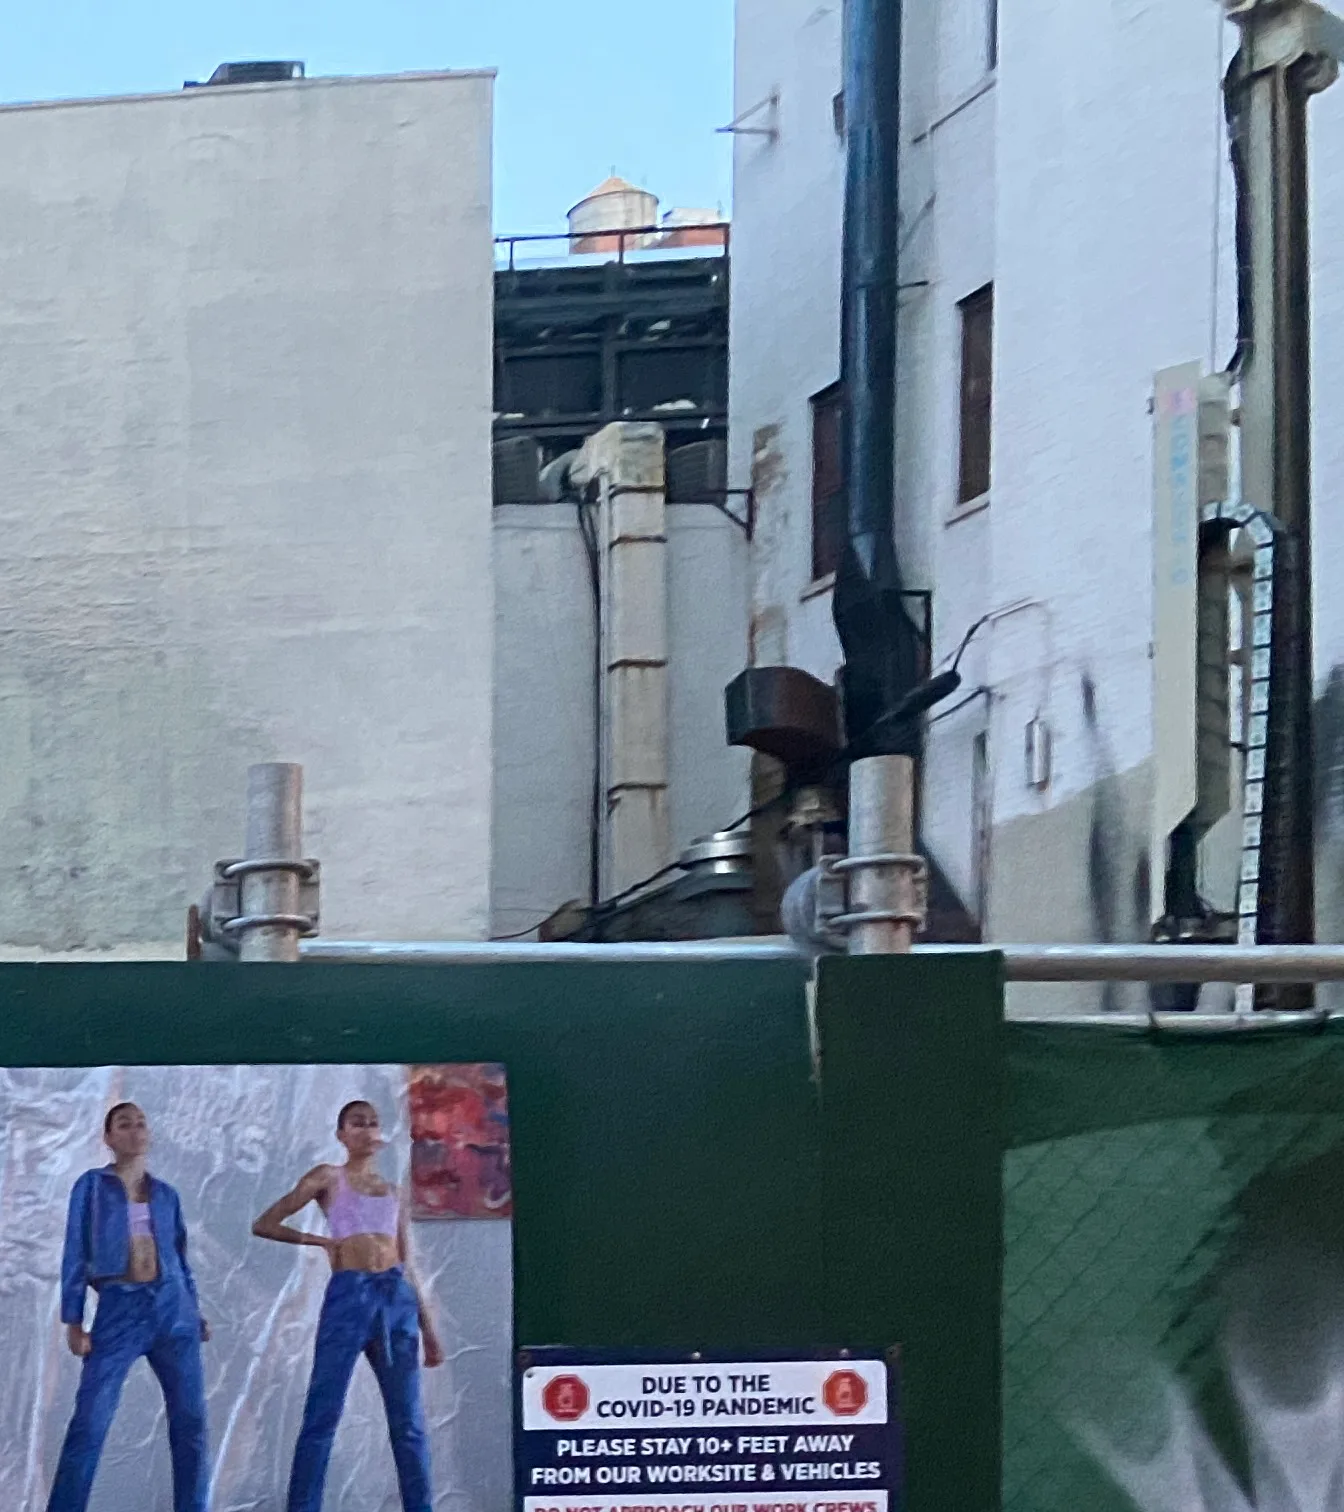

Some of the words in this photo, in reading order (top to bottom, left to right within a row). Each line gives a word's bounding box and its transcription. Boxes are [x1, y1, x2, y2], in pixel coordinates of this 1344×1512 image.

[642, 1376, 686, 1394] DUE
[692, 1376, 721, 1393] TO
[728, 1375, 770, 1392] THE
[597, 1399, 695, 1417] COVID-19
[703, 1397, 815, 1416] PANDEMIC
[557, 1439, 636, 1456] PLEASE
[641, 1438, 692, 1455] STAY
[696, 1437, 732, 1454] 10+
[738, 1436, 789, 1453] FEET
[793, 1435, 854, 1452] AWAY
[531, 1467, 590, 1484] FROM
[596, 1466, 641, 1483] OUR
[647, 1464, 756, 1482] WORKSITE
[762, 1464, 775, 1481] &
[780, 1462, 880, 1480] VEHICLES
